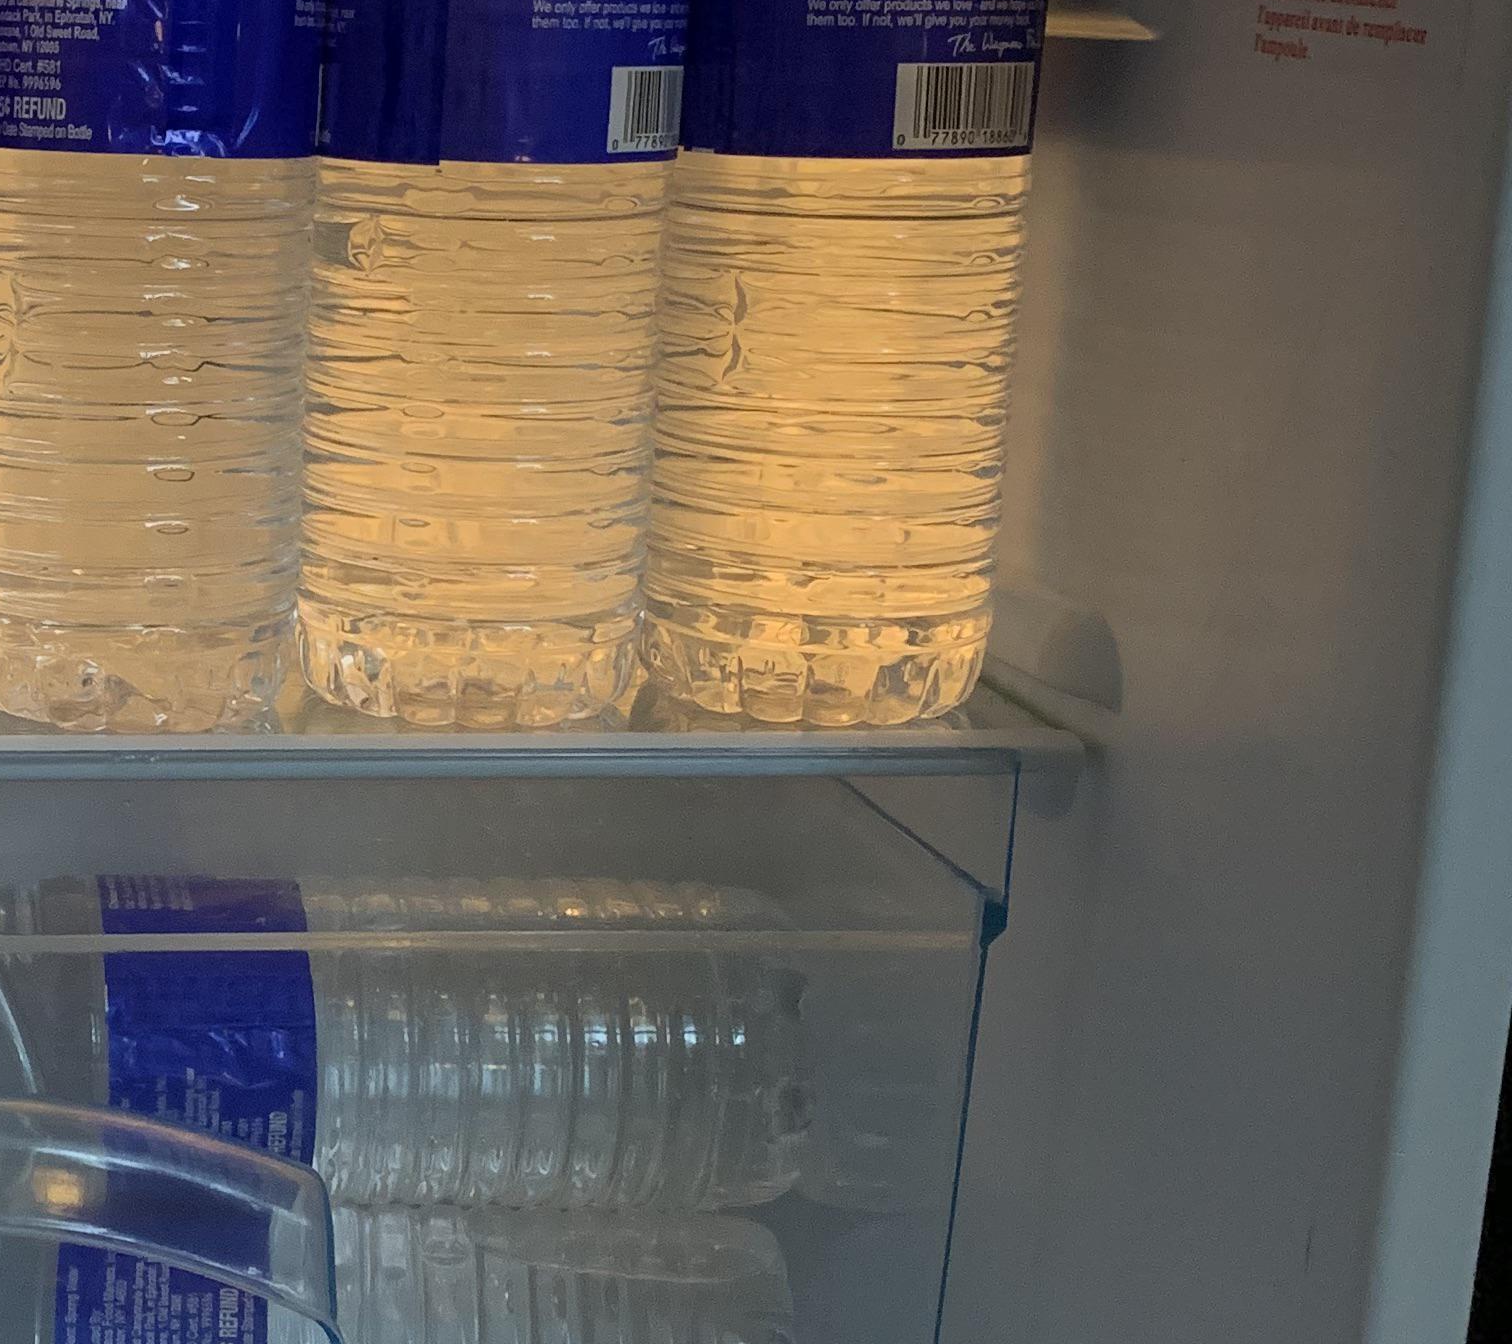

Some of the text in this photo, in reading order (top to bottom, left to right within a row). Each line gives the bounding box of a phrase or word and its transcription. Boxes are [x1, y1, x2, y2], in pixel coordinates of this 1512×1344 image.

[806, 13, 835, 28] them
[13, 96, 67, 121] REFUND
[896, 133, 906, 146] 0
[218, 1286, 238, 1338] REFUND
